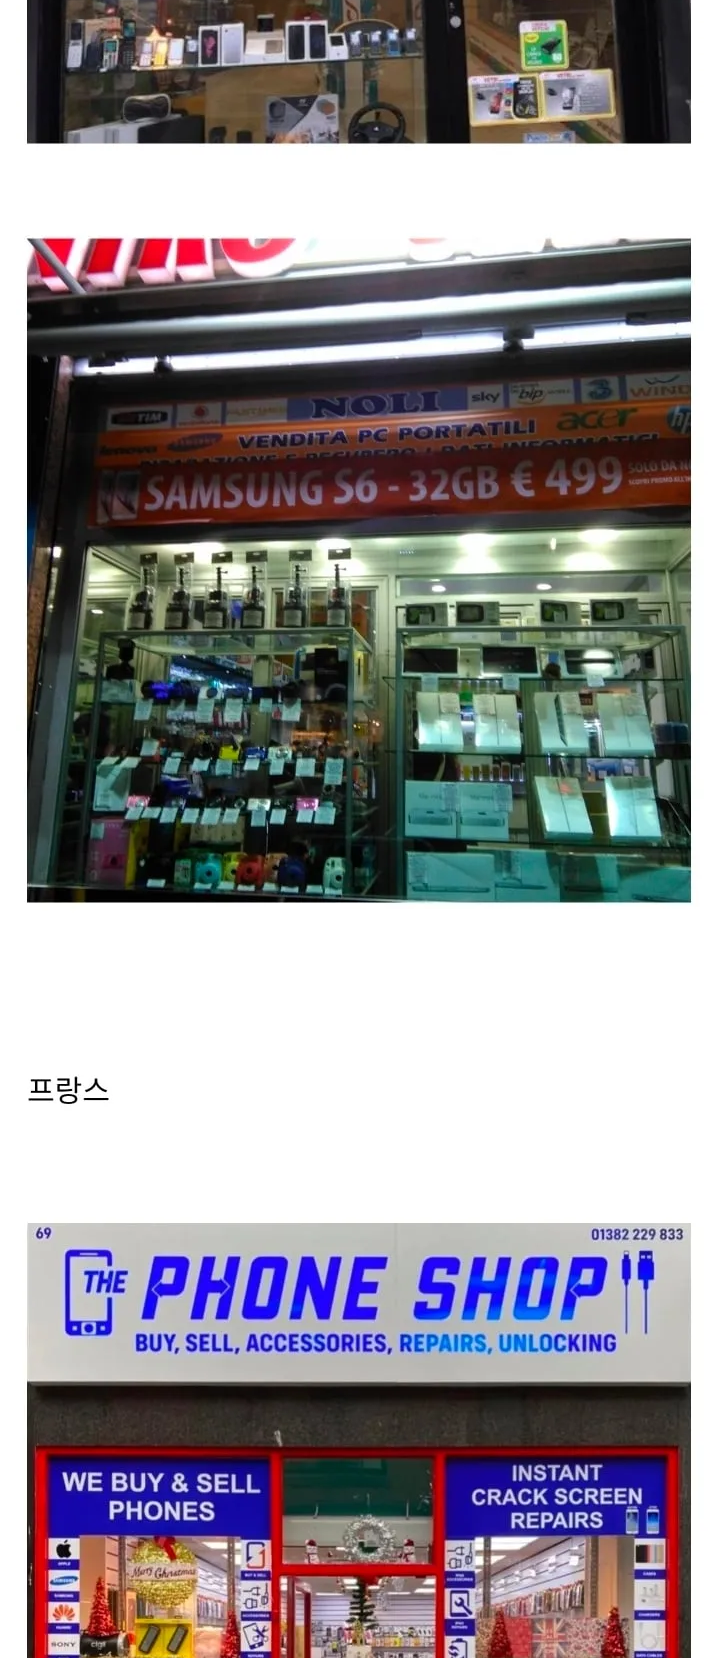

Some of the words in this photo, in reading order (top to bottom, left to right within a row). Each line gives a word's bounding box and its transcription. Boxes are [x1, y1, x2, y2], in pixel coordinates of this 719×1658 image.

[311, 390, 440, 419] NOLI
[237, 429, 348, 449] VENDITA
[358, 428, 389, 443] PC
[398, 419, 536, 441] PORTATILI
[144, 470, 324, 511] SAMSUNG
[333, 468, 378, 504] S6
[409, 465, 500, 502] 32GB
[510, 460, 535, 498] €
[544, 455, 623, 496] 499
[83, 1270, 128, 1294] THE
[140, 1256, 389, 1320] PHONE
[413, 1256, 608, 1321] SHOP
[499, 1333, 617, 1353] UNLOCKING
[62, 1472, 103, 1492] WE
[111, 1472, 164, 1493] BUY
[171, 1473, 189, 1493] &
[196, 1473, 261, 1494] SELL
[109, 1501, 216, 1522] PHONES
